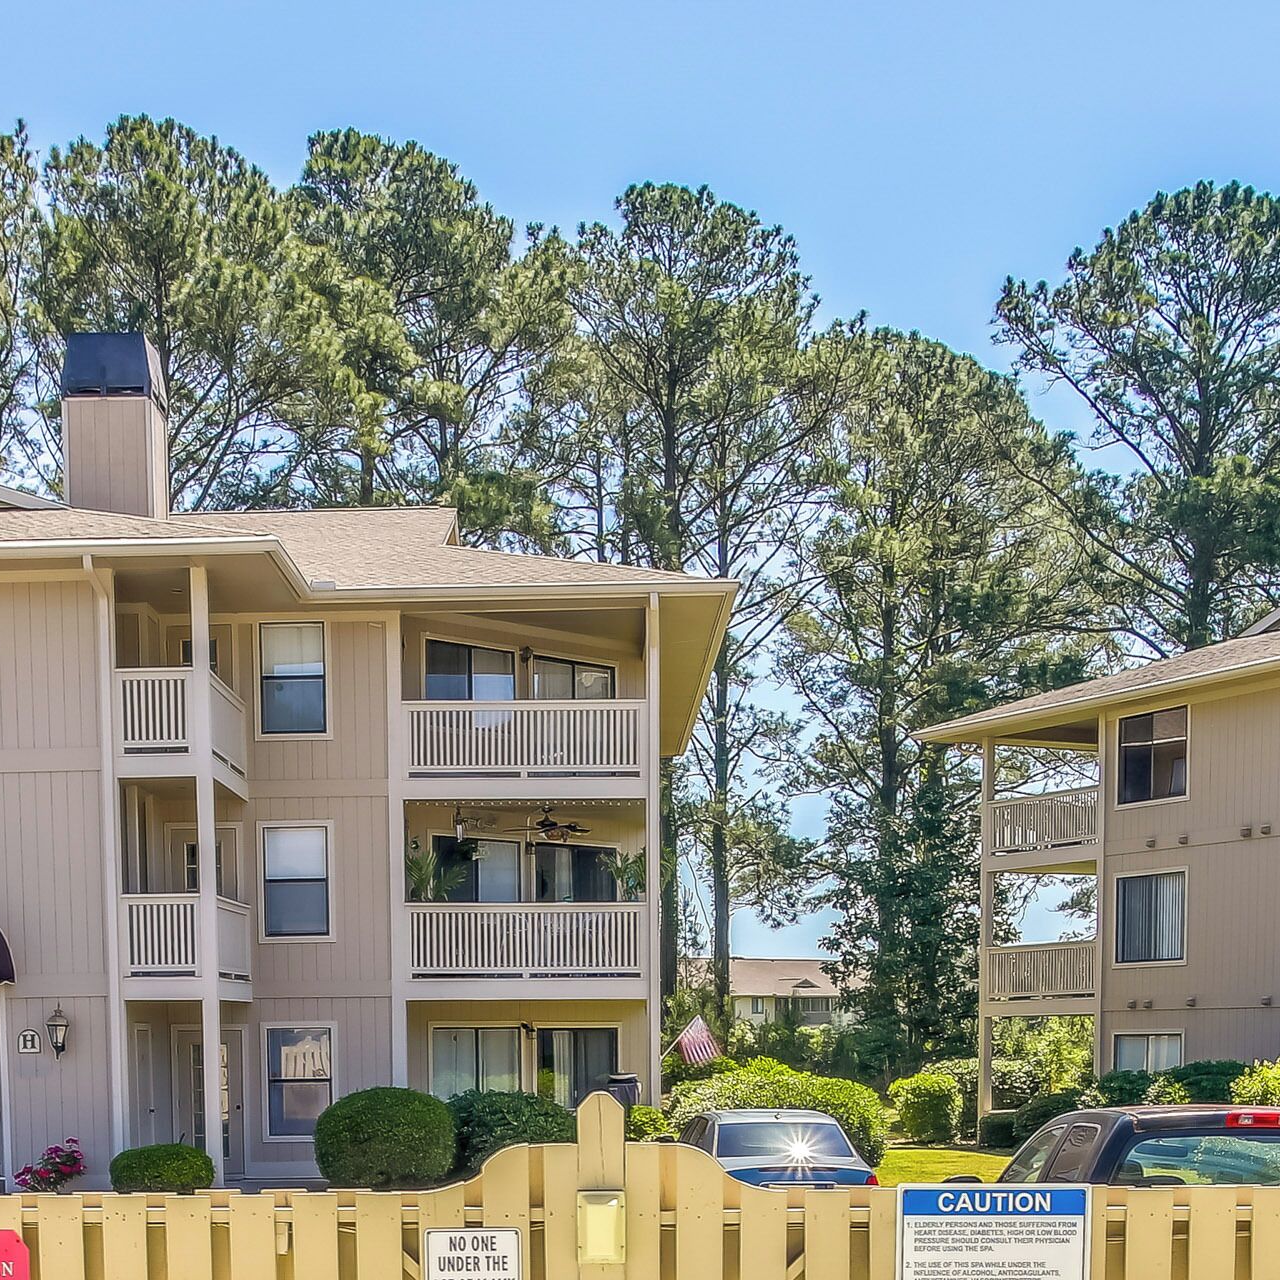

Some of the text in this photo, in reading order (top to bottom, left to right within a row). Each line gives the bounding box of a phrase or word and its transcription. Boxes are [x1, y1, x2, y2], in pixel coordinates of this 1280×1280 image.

[21, 1033, 37, 1050] H
[937, 1192, 1052, 1213] CAUTION
[449, 1236, 497, 1252] NO ONE
[438, 1256, 508, 1272] UNDER THE
